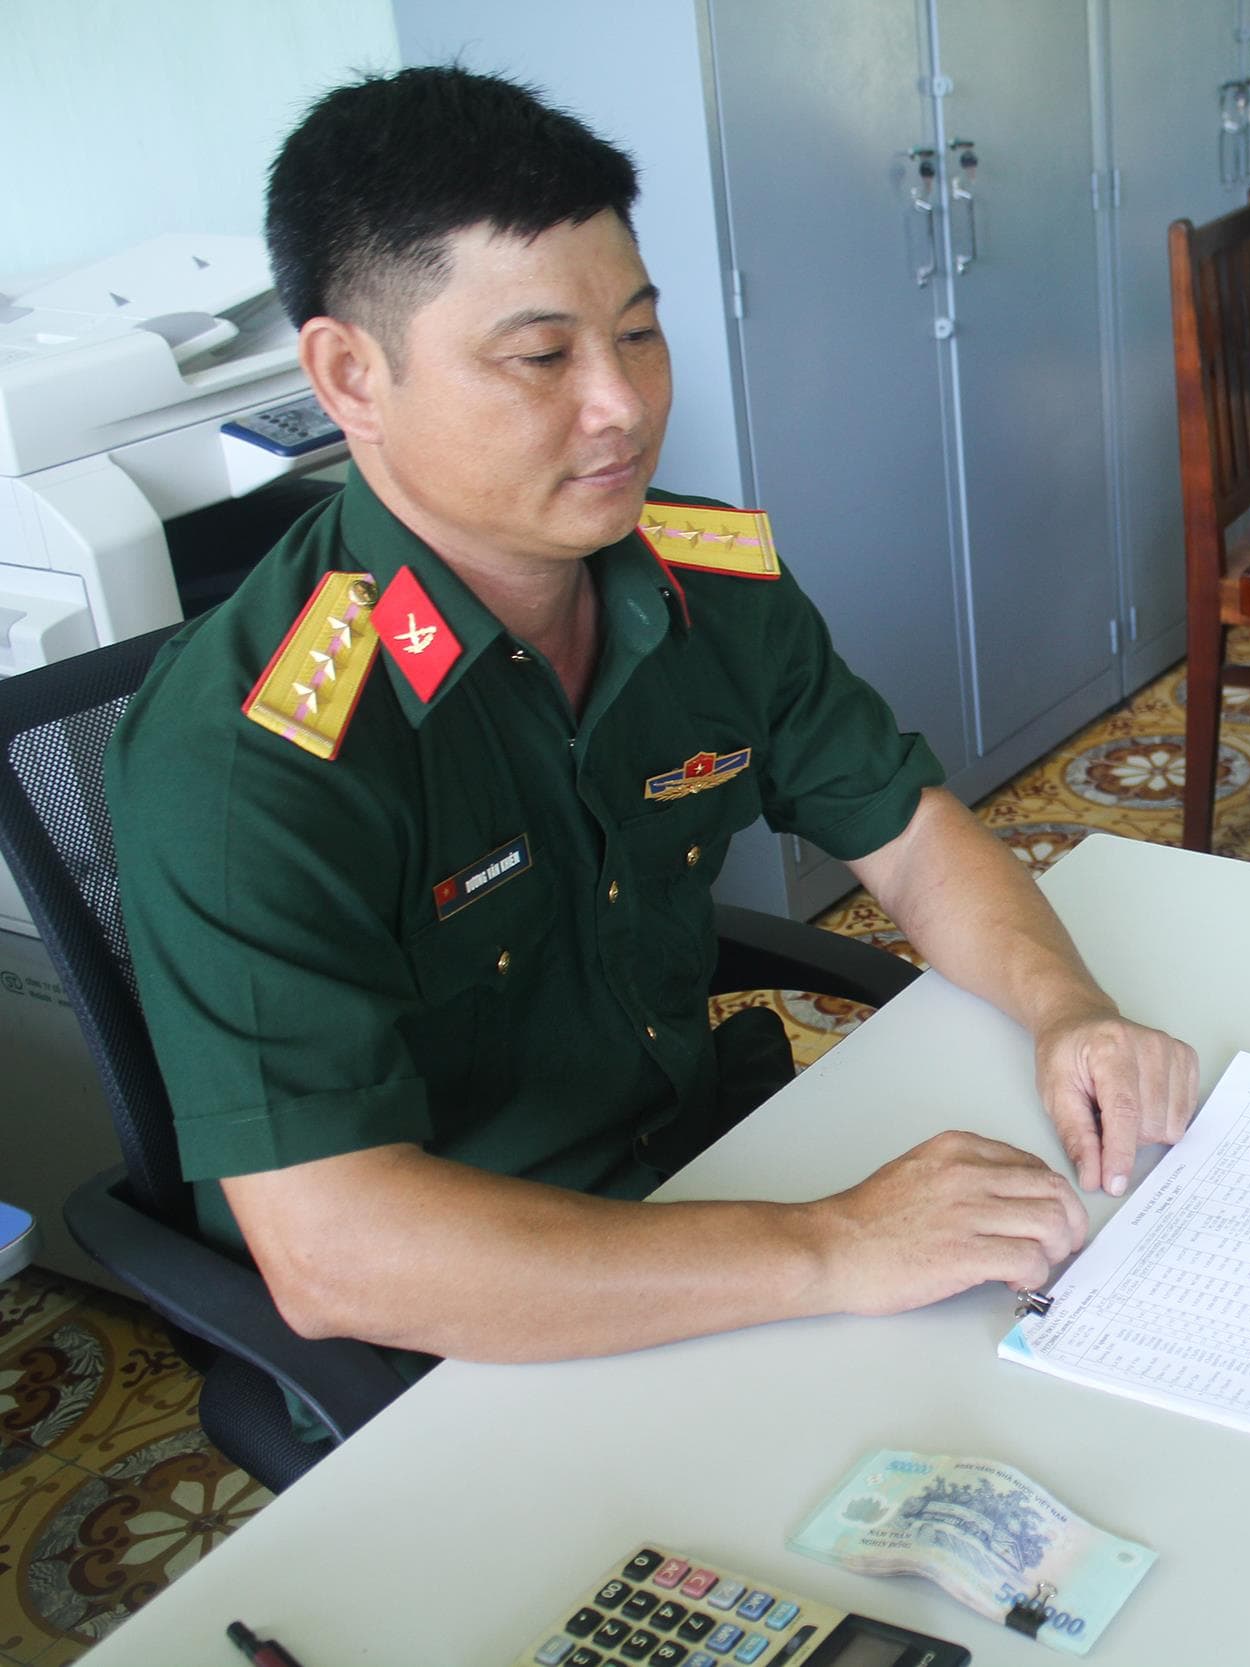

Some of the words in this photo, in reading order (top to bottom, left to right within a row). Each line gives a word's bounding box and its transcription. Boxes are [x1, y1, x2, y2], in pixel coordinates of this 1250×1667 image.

[635, 1555, 650, 1567] 0
[662, 1560, 681, 1579] AC
[601, 1582, 622, 1599] 00
[632, 1596, 646, 1607] 1
[660, 1605, 675, 1619] 4
[601, 1622, 620, 1637] 2
[688, 1618, 704, 1631] 7
[630, 1635, 648, 1648] 5
[573, 1653, 589, 1666] 3
[658, 1647, 675, 1660] 8
